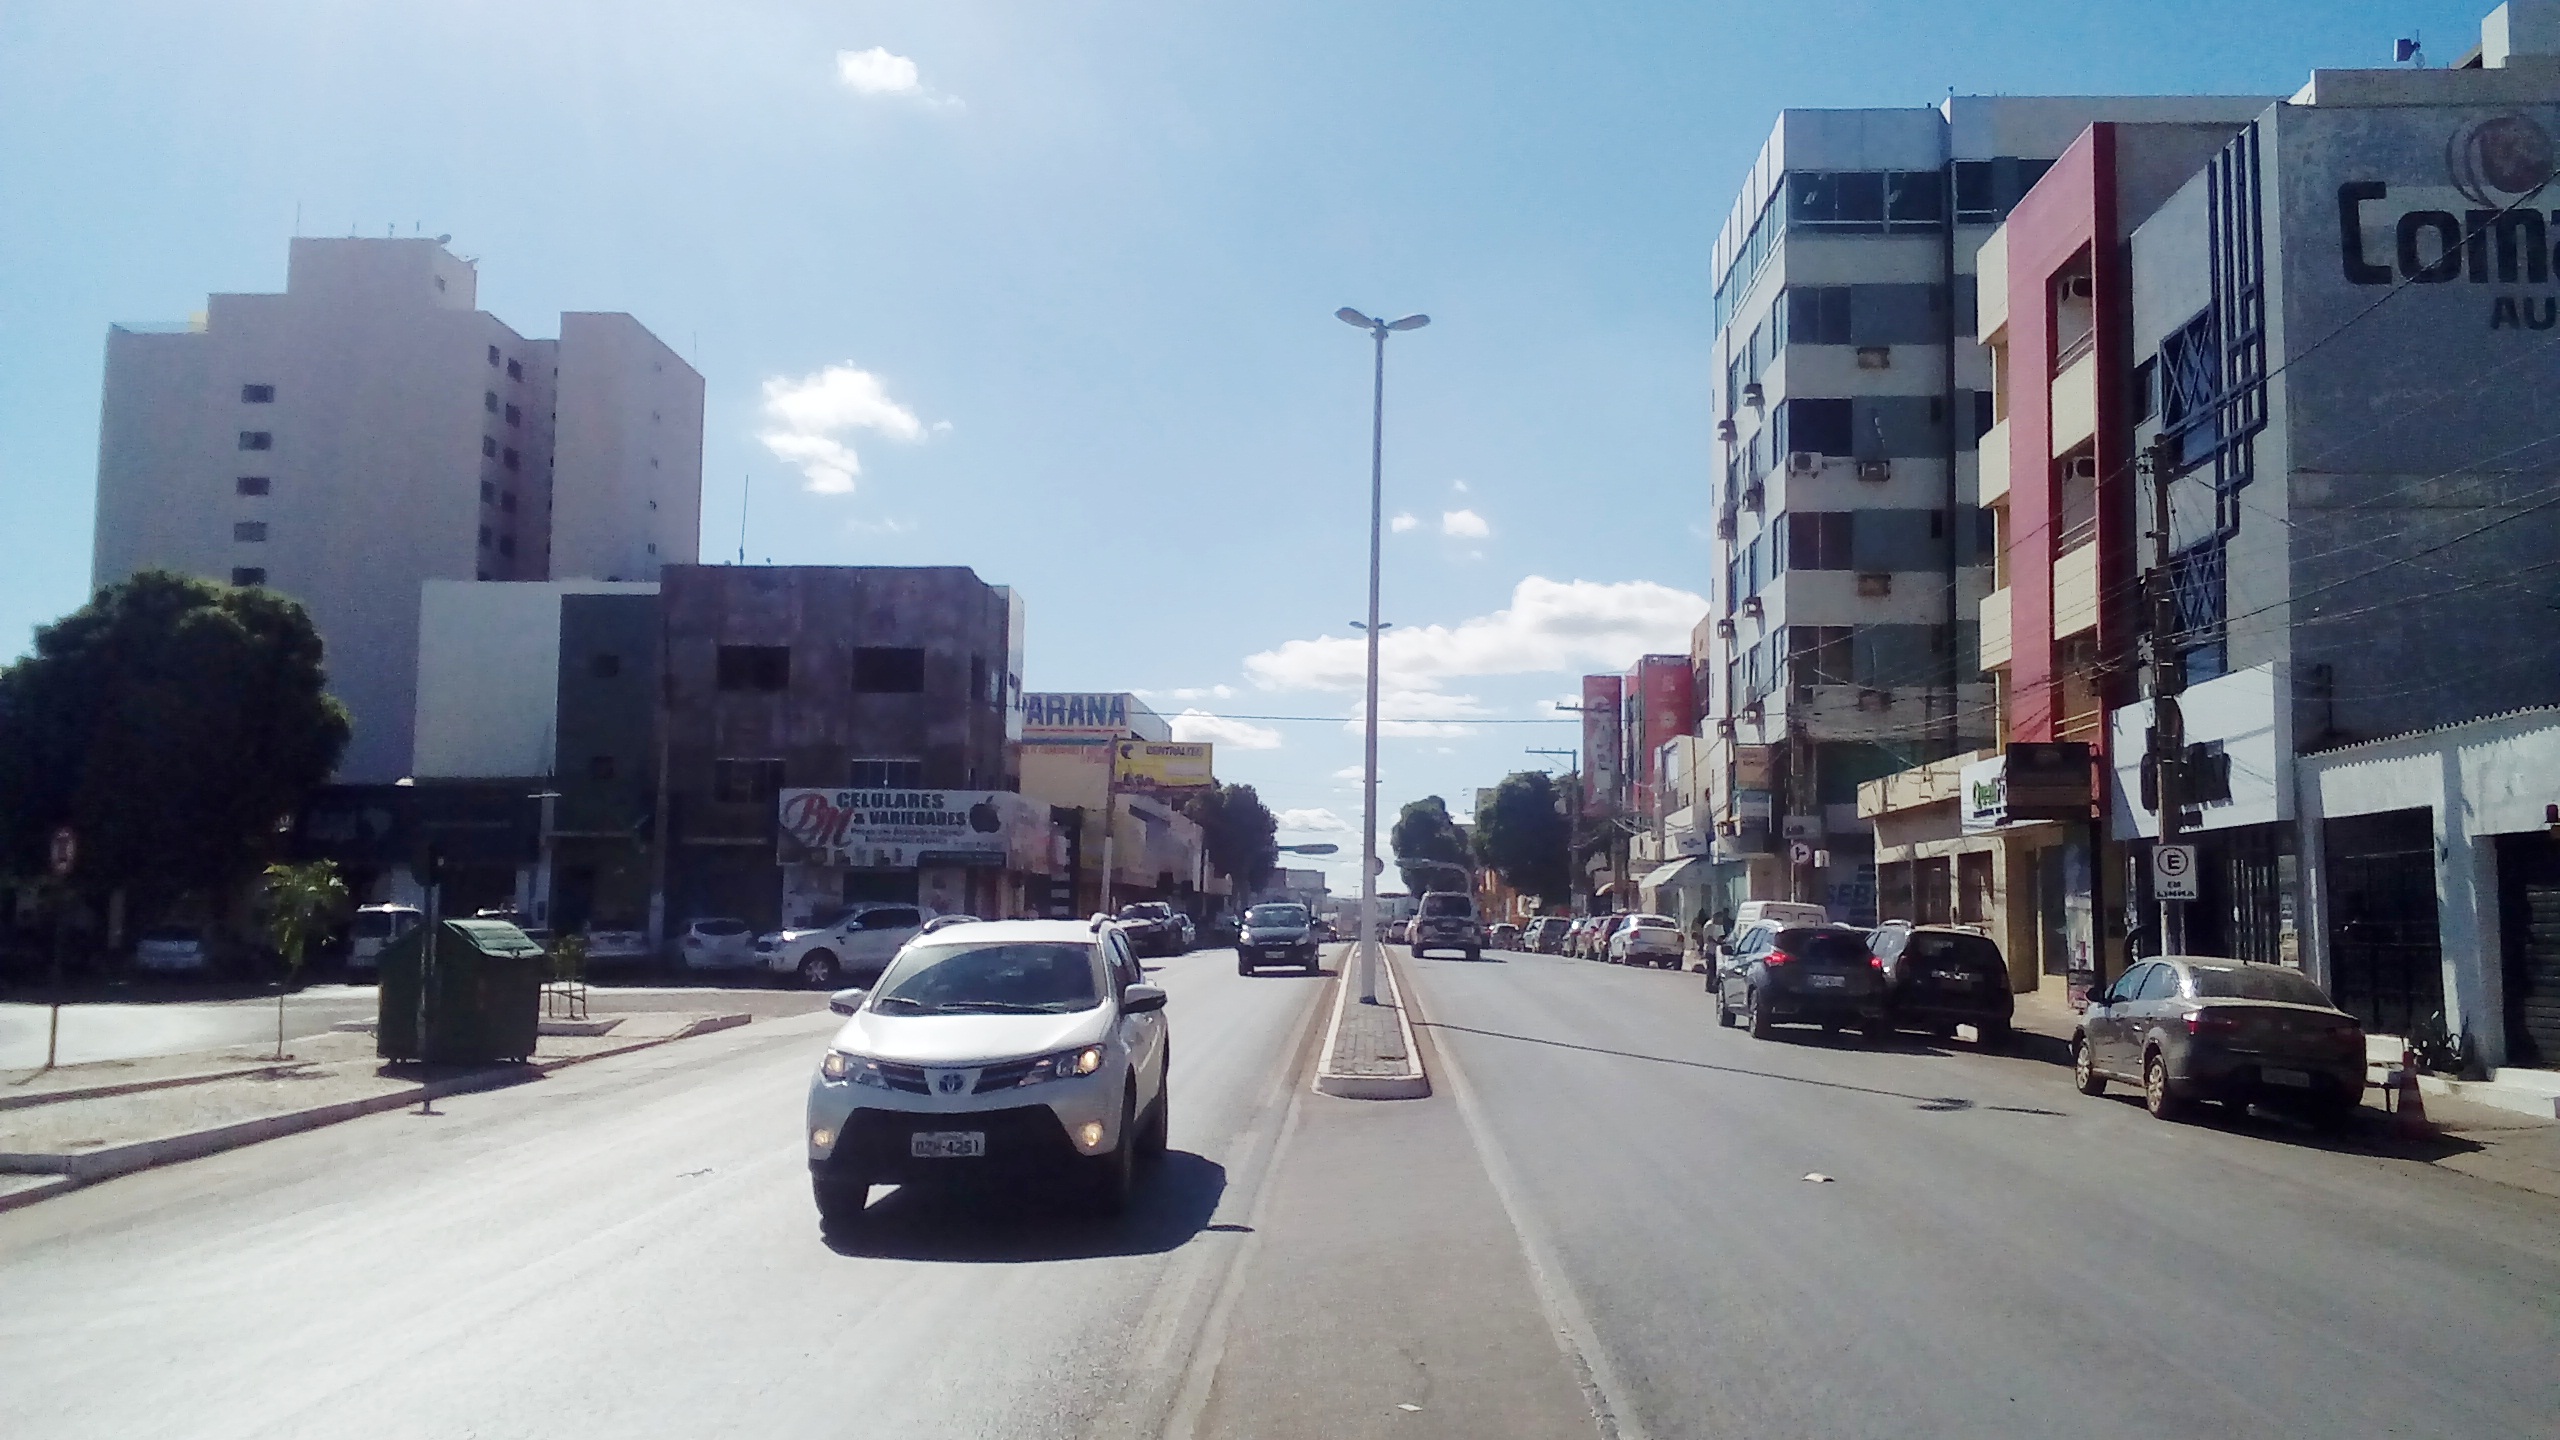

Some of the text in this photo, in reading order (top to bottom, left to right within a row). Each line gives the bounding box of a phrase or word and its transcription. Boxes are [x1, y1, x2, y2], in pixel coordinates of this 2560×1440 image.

[2337, 180, 2560, 285] Com
[836, 792, 945, 809] CELULARES
[869, 811, 967, 826] VARIEDADES
[2167, 854, 2181, 870] E
